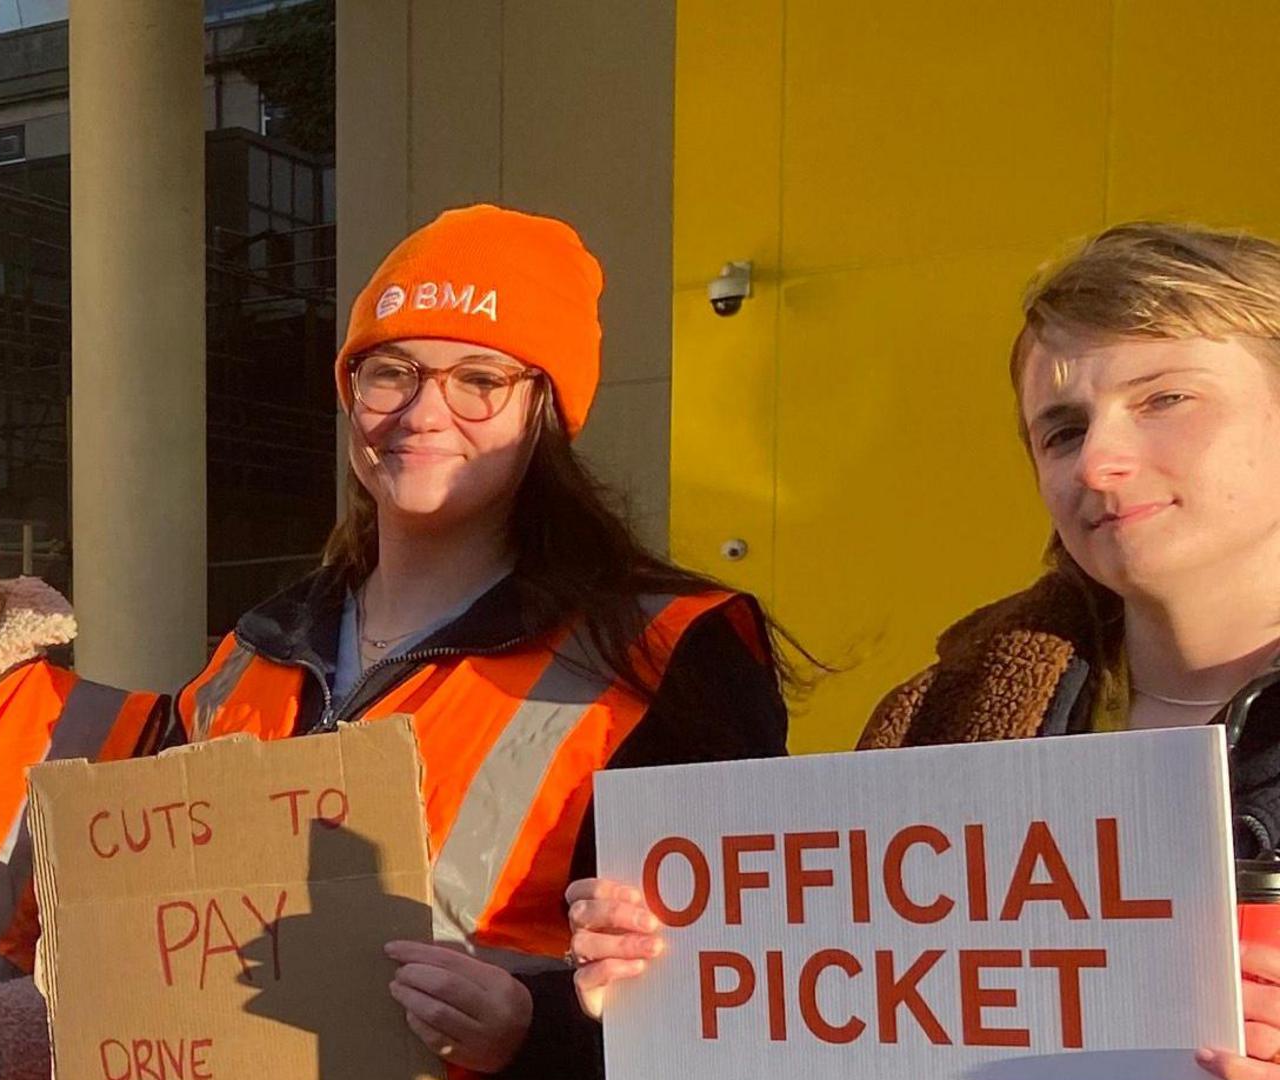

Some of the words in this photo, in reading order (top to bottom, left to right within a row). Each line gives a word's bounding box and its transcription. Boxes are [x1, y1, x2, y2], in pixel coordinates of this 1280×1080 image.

[415, 282, 498, 322] BMA
[87, 801, 214, 859] CUTS
[269, 787, 350, 837] TO
[641, 818, 1173, 929] OFFICIAL
[155, 890, 288, 991] PAY
[698, 947, 1108, 1049] PICKET
